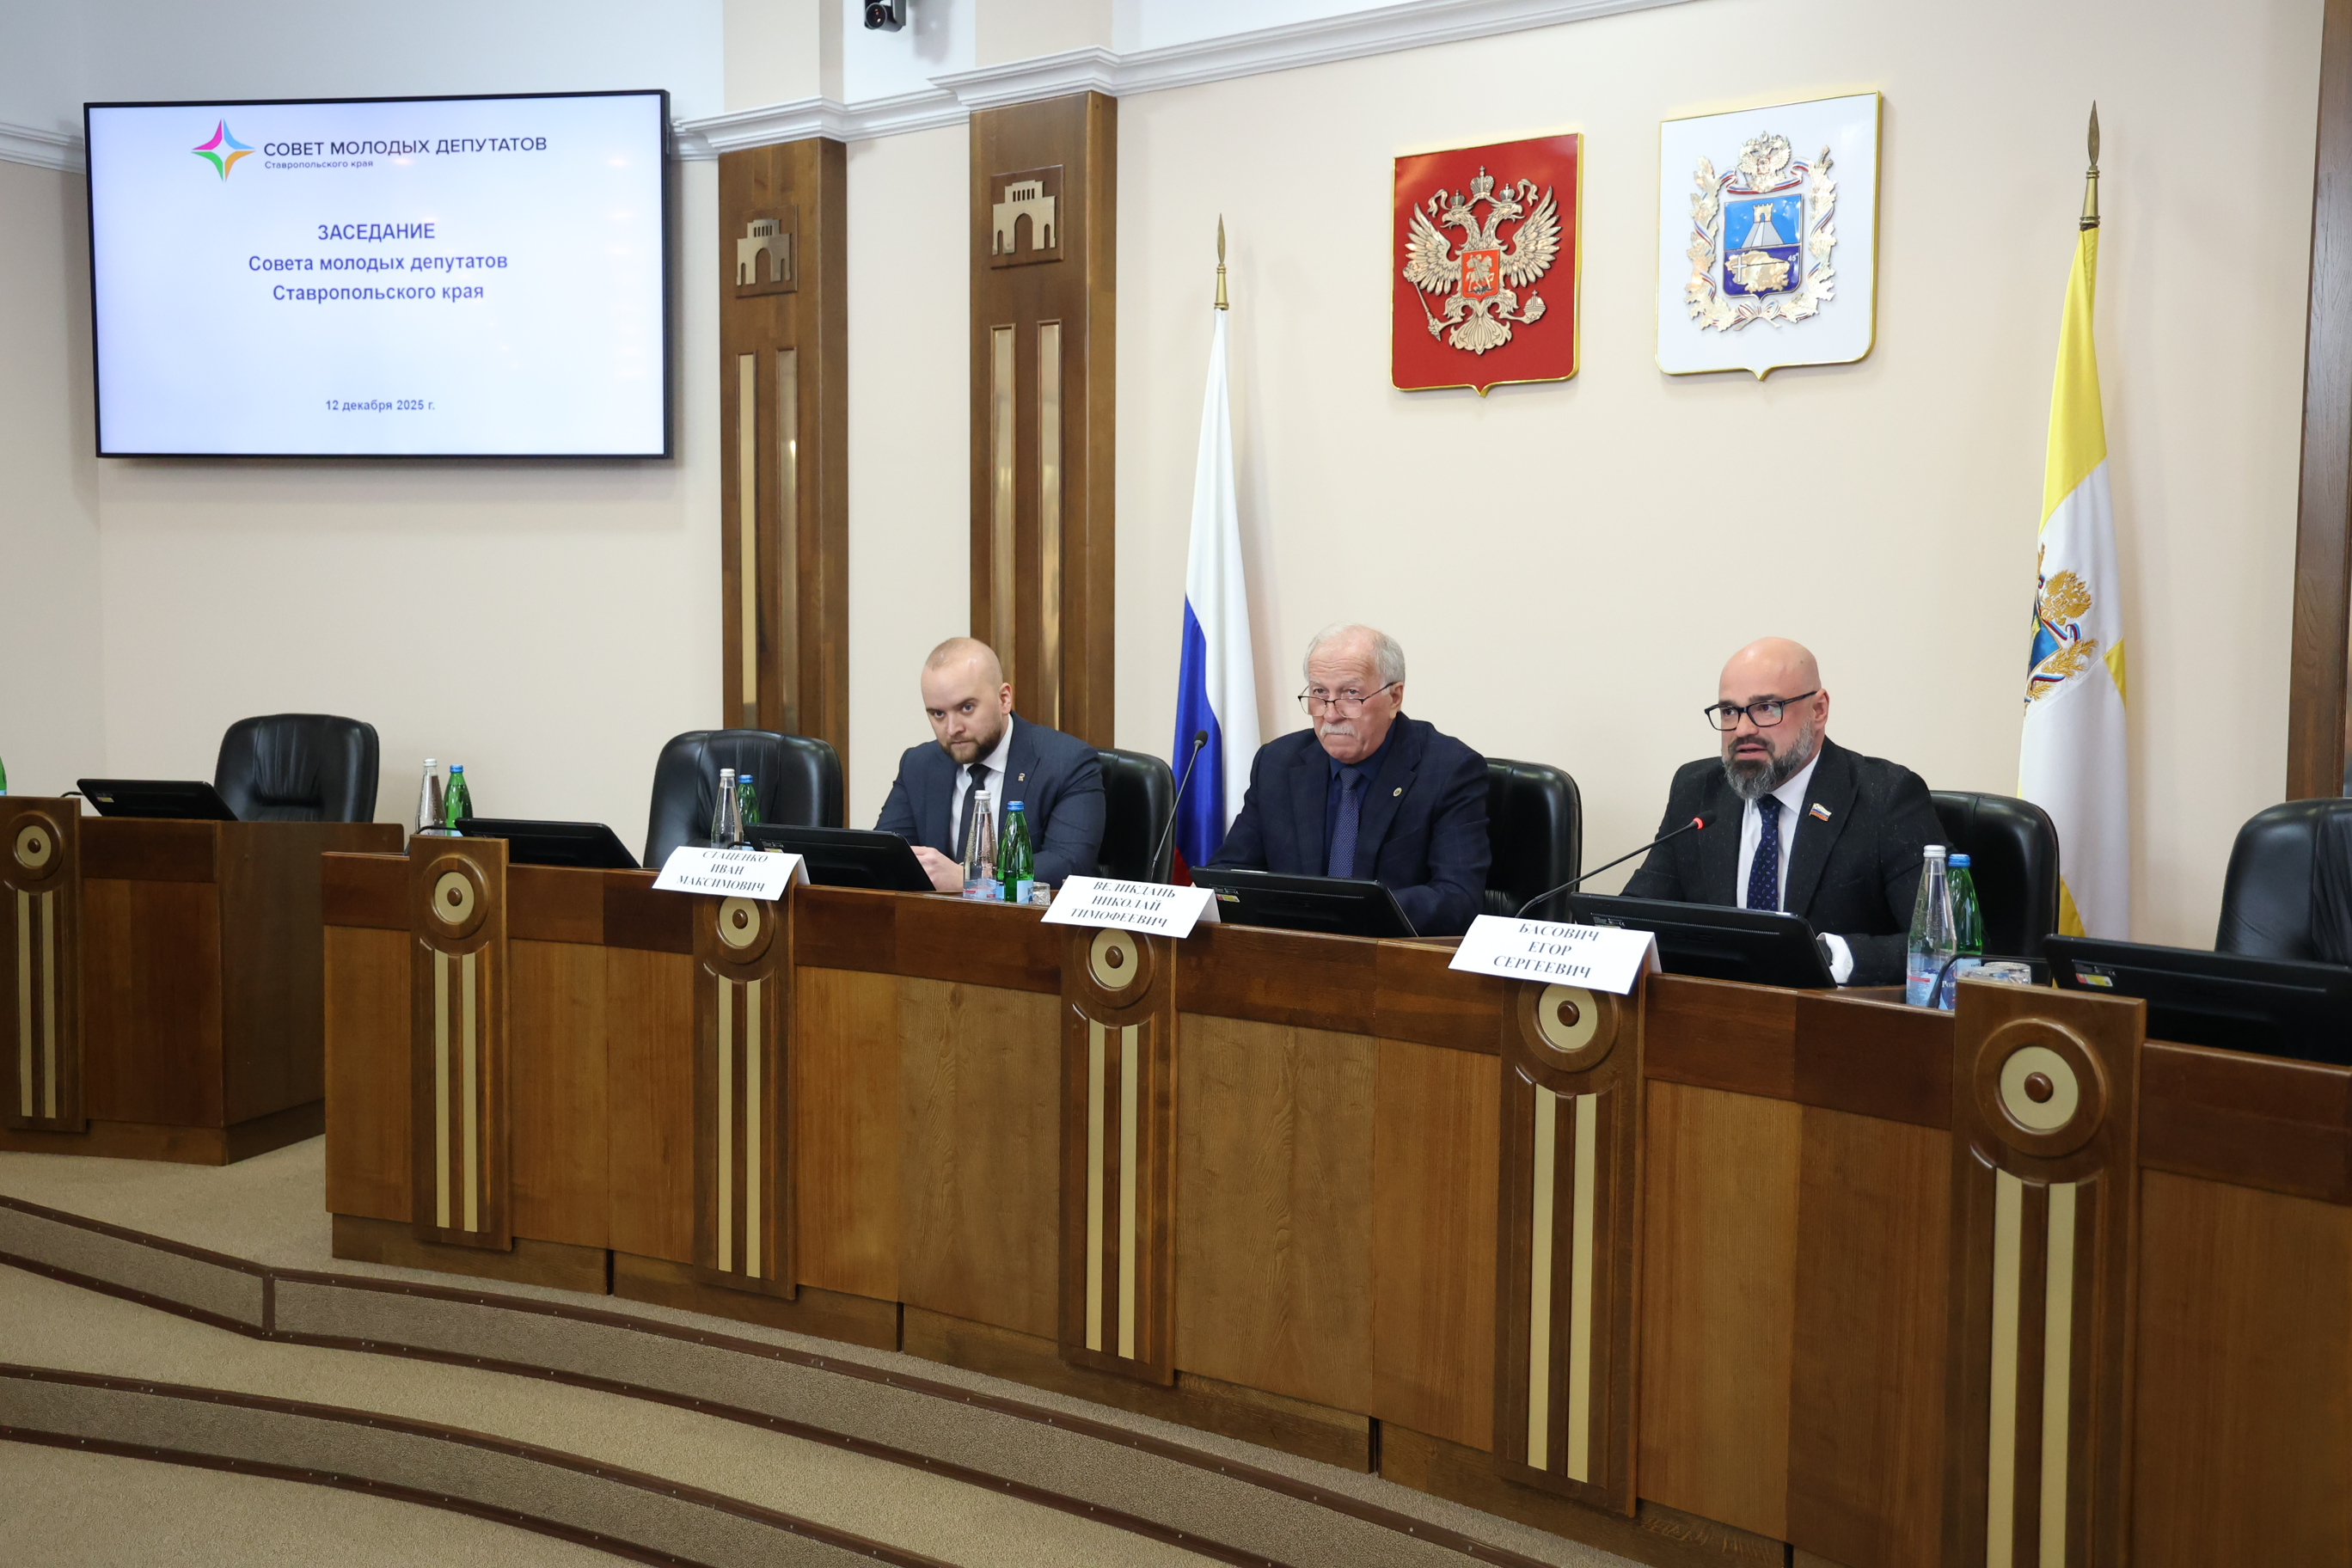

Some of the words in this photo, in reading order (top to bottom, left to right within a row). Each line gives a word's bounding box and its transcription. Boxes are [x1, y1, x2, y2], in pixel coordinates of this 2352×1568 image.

[263, 140, 325, 157] СОВЕТ
[330, 138, 431, 157] МОЛОДЫХ
[435, 135, 548, 156] ДЕПУТАТОВ
[264, 160, 348, 170] Ставропольского
[351, 160, 374, 169] края
[317, 222, 436, 243] ЗАСЕДАНИЕ
[248, 254, 314, 272] Совета
[319, 256, 405, 273] молодых
[409, 253, 508, 274] депутатов
[273, 282, 436, 304] Ставропольского
[442, 285, 484, 303] края
[326, 399, 339, 411] 12
[342, 398, 393, 413] декабря
[396, 399, 425, 411] 2025
[702, 850, 769, 863] СТАЦЕНКО
[709, 863, 745, 875] ИВАН
[677, 875, 766, 892] МАКСИМОВИЧ
[1093, 880, 1176, 898] ВЕЛИКДАНЬ
[1091, 895, 1162, 912] НИКОЛАЙ
[1070, 908, 1168, 928] ТИМОФЕЕВИЧ
[1519, 922, 1601, 942] БАСОВИЧ
[1528, 940, 1572, 957] ЕГОР
[1493, 955, 1592, 979] СЕРГЕЕВИЧ
